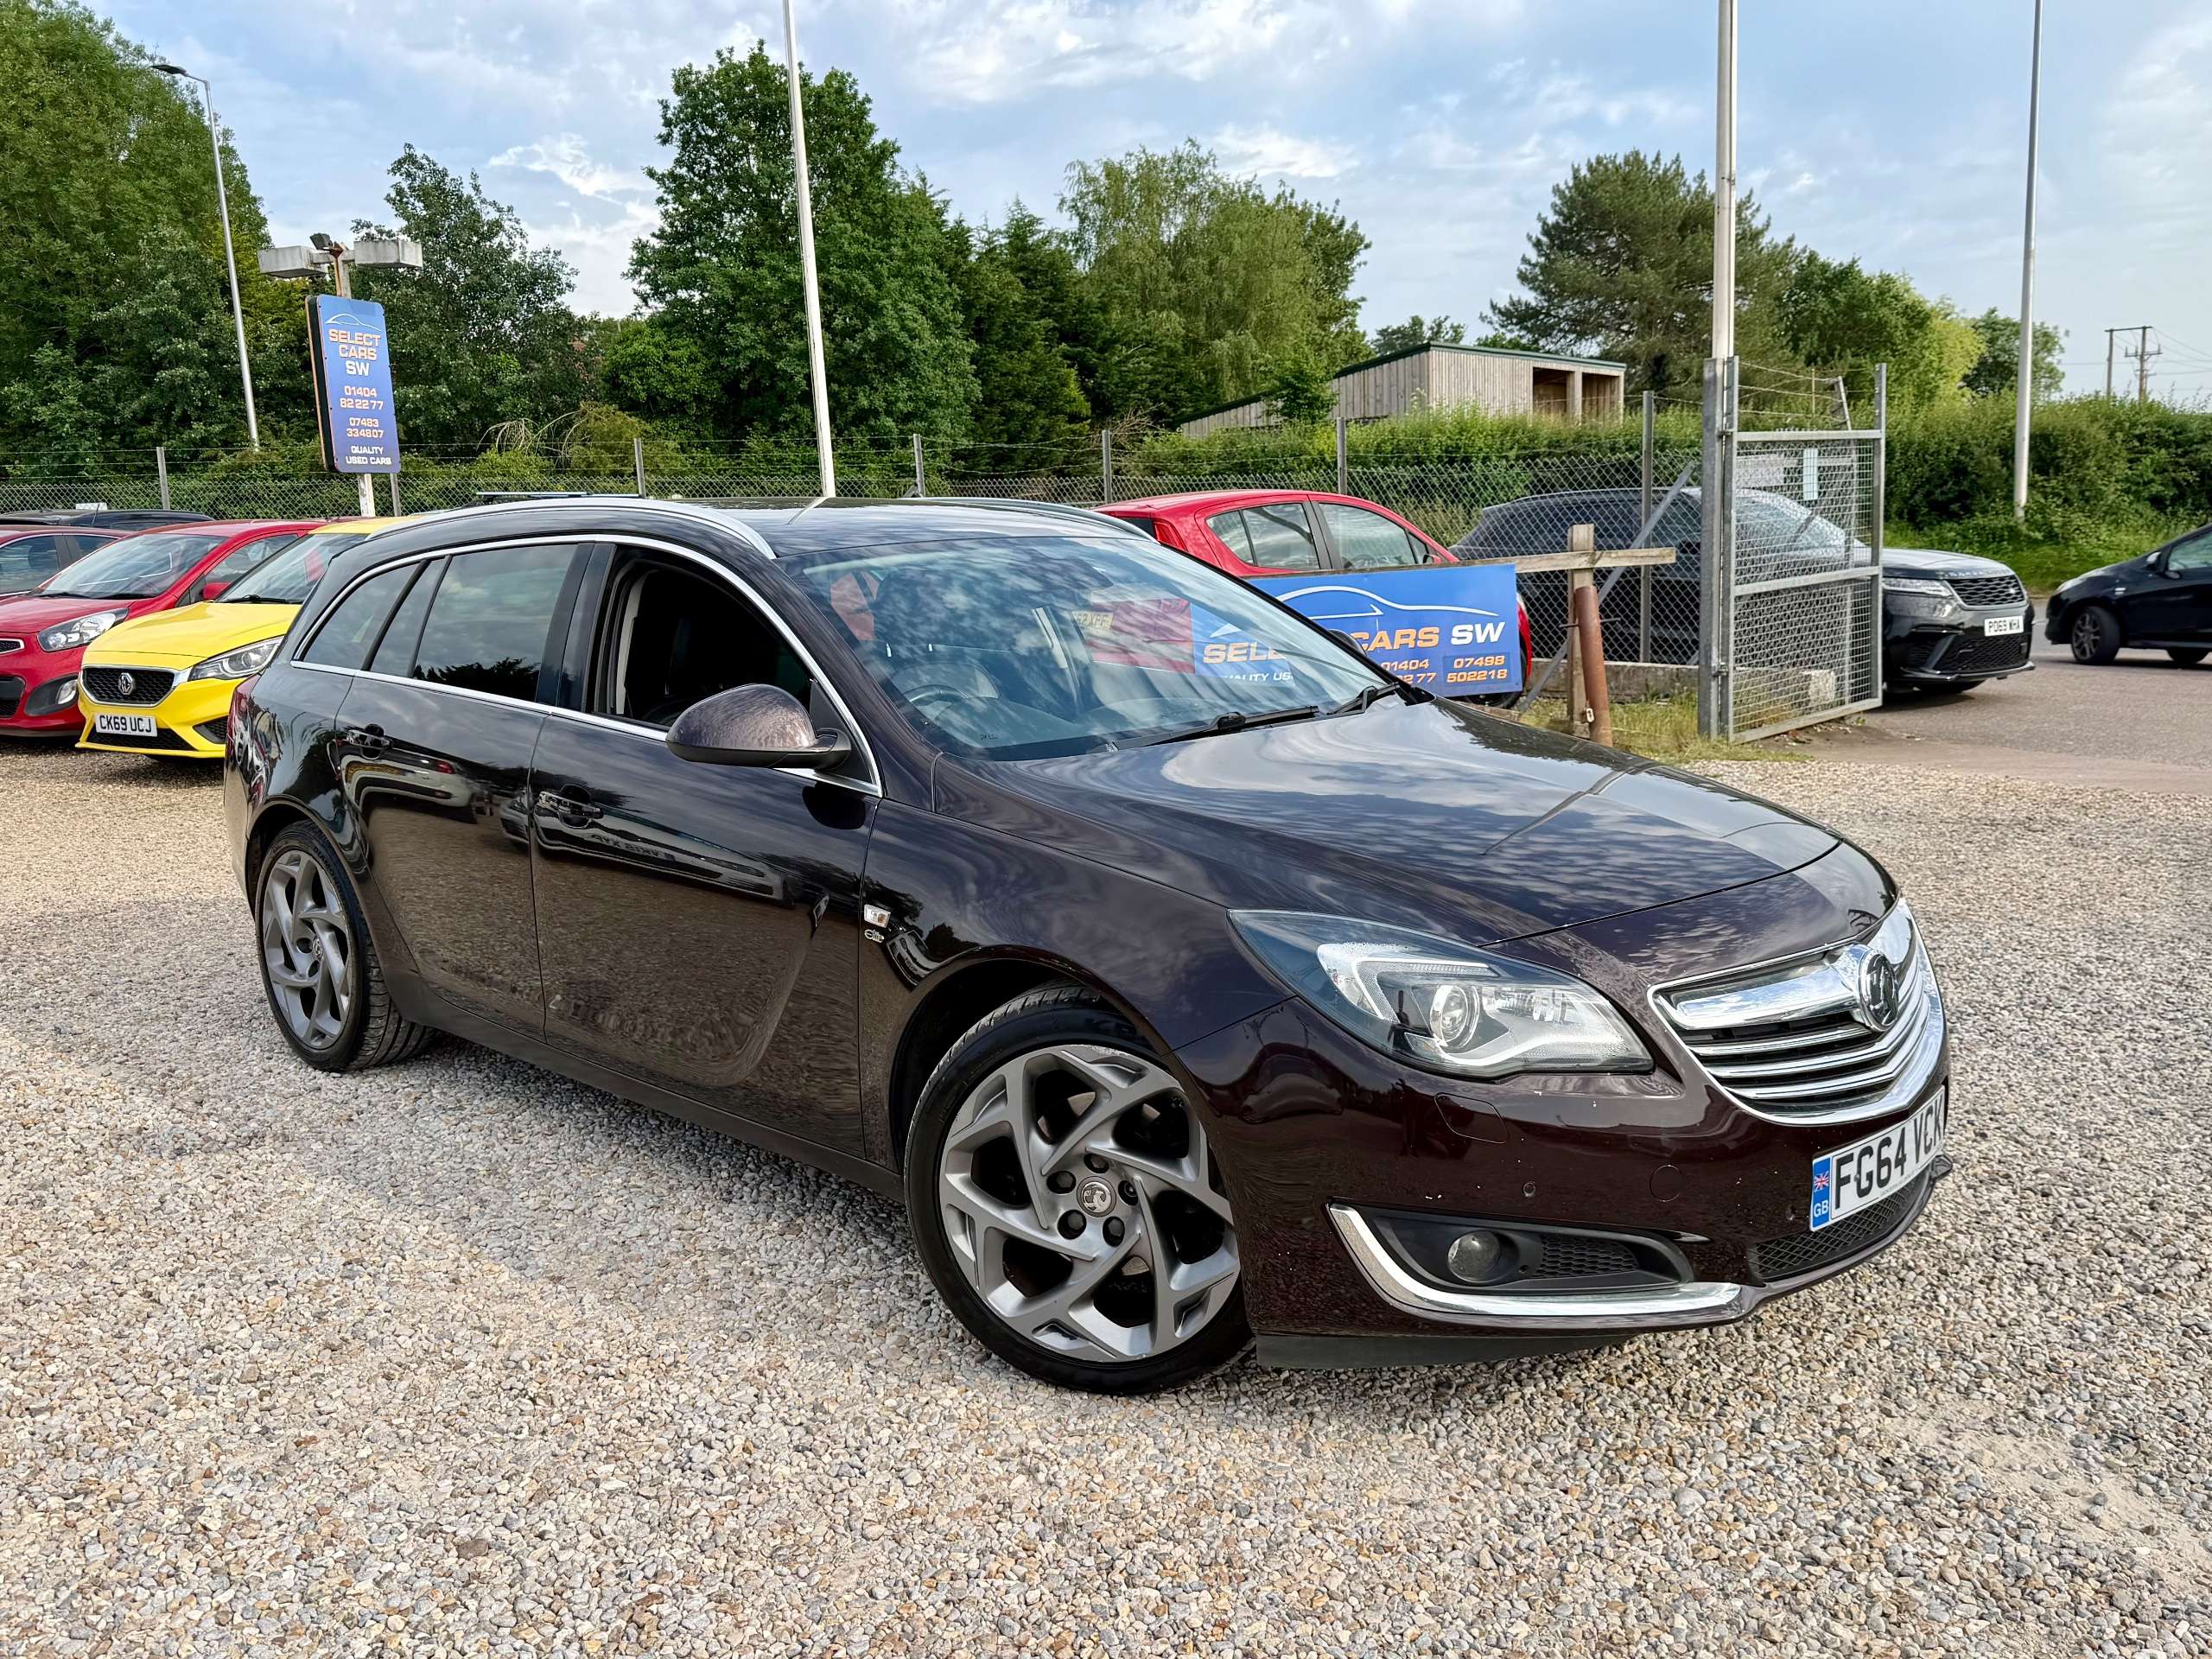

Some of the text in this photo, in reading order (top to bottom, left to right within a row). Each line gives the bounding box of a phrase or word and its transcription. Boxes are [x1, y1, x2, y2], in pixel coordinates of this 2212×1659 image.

[328, 328, 381, 346] SELECT
[339, 344, 378, 361] CARS
[346, 359, 370, 377] SW
[344, 385, 378, 397] 01404
[349, 416, 379, 428] 07483
[346, 428, 385, 439] 334807
[351, 445, 384, 454] QUALITY
[346, 455, 392, 466] USED CARS
[1451, 621, 1506, 645] SW
[1381, 658, 1429, 671] 01404
[1446, 669, 1509, 683] 502218
[99, 715, 152, 734] CK69 UCJ
[1834, 1094, 1942, 1210] FG64 VCK
[1814, 1199, 1829, 1217] GB
